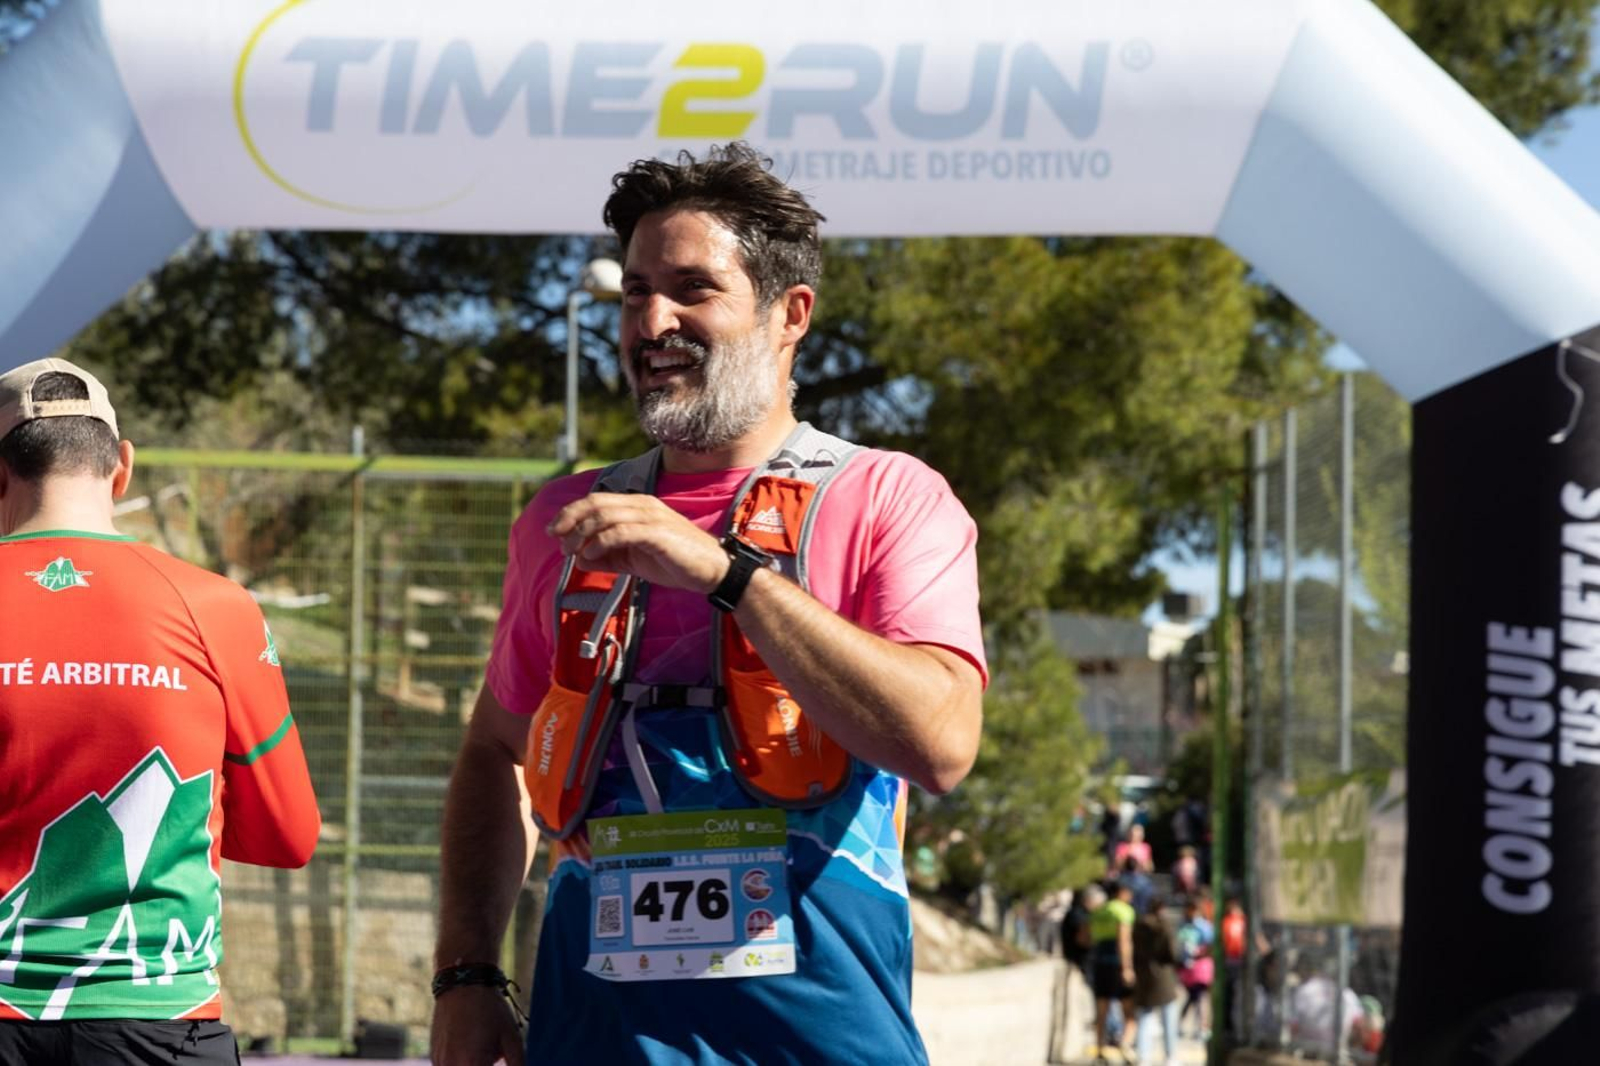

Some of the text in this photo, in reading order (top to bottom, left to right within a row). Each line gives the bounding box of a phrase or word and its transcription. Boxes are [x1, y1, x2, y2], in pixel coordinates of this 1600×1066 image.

[284, 37, 1113, 140] TIME2RUN
[927, 149, 1112, 182] DEPORTIVO
[1559, 481, 1600, 767] TUS METAS
[0, 658, 188, 690] TÉ ARBITRAL
[1481, 621, 1556, 915] CONSIGUE
[704, 833, 740, 848] 2025
[633, 878, 730, 922] 476
